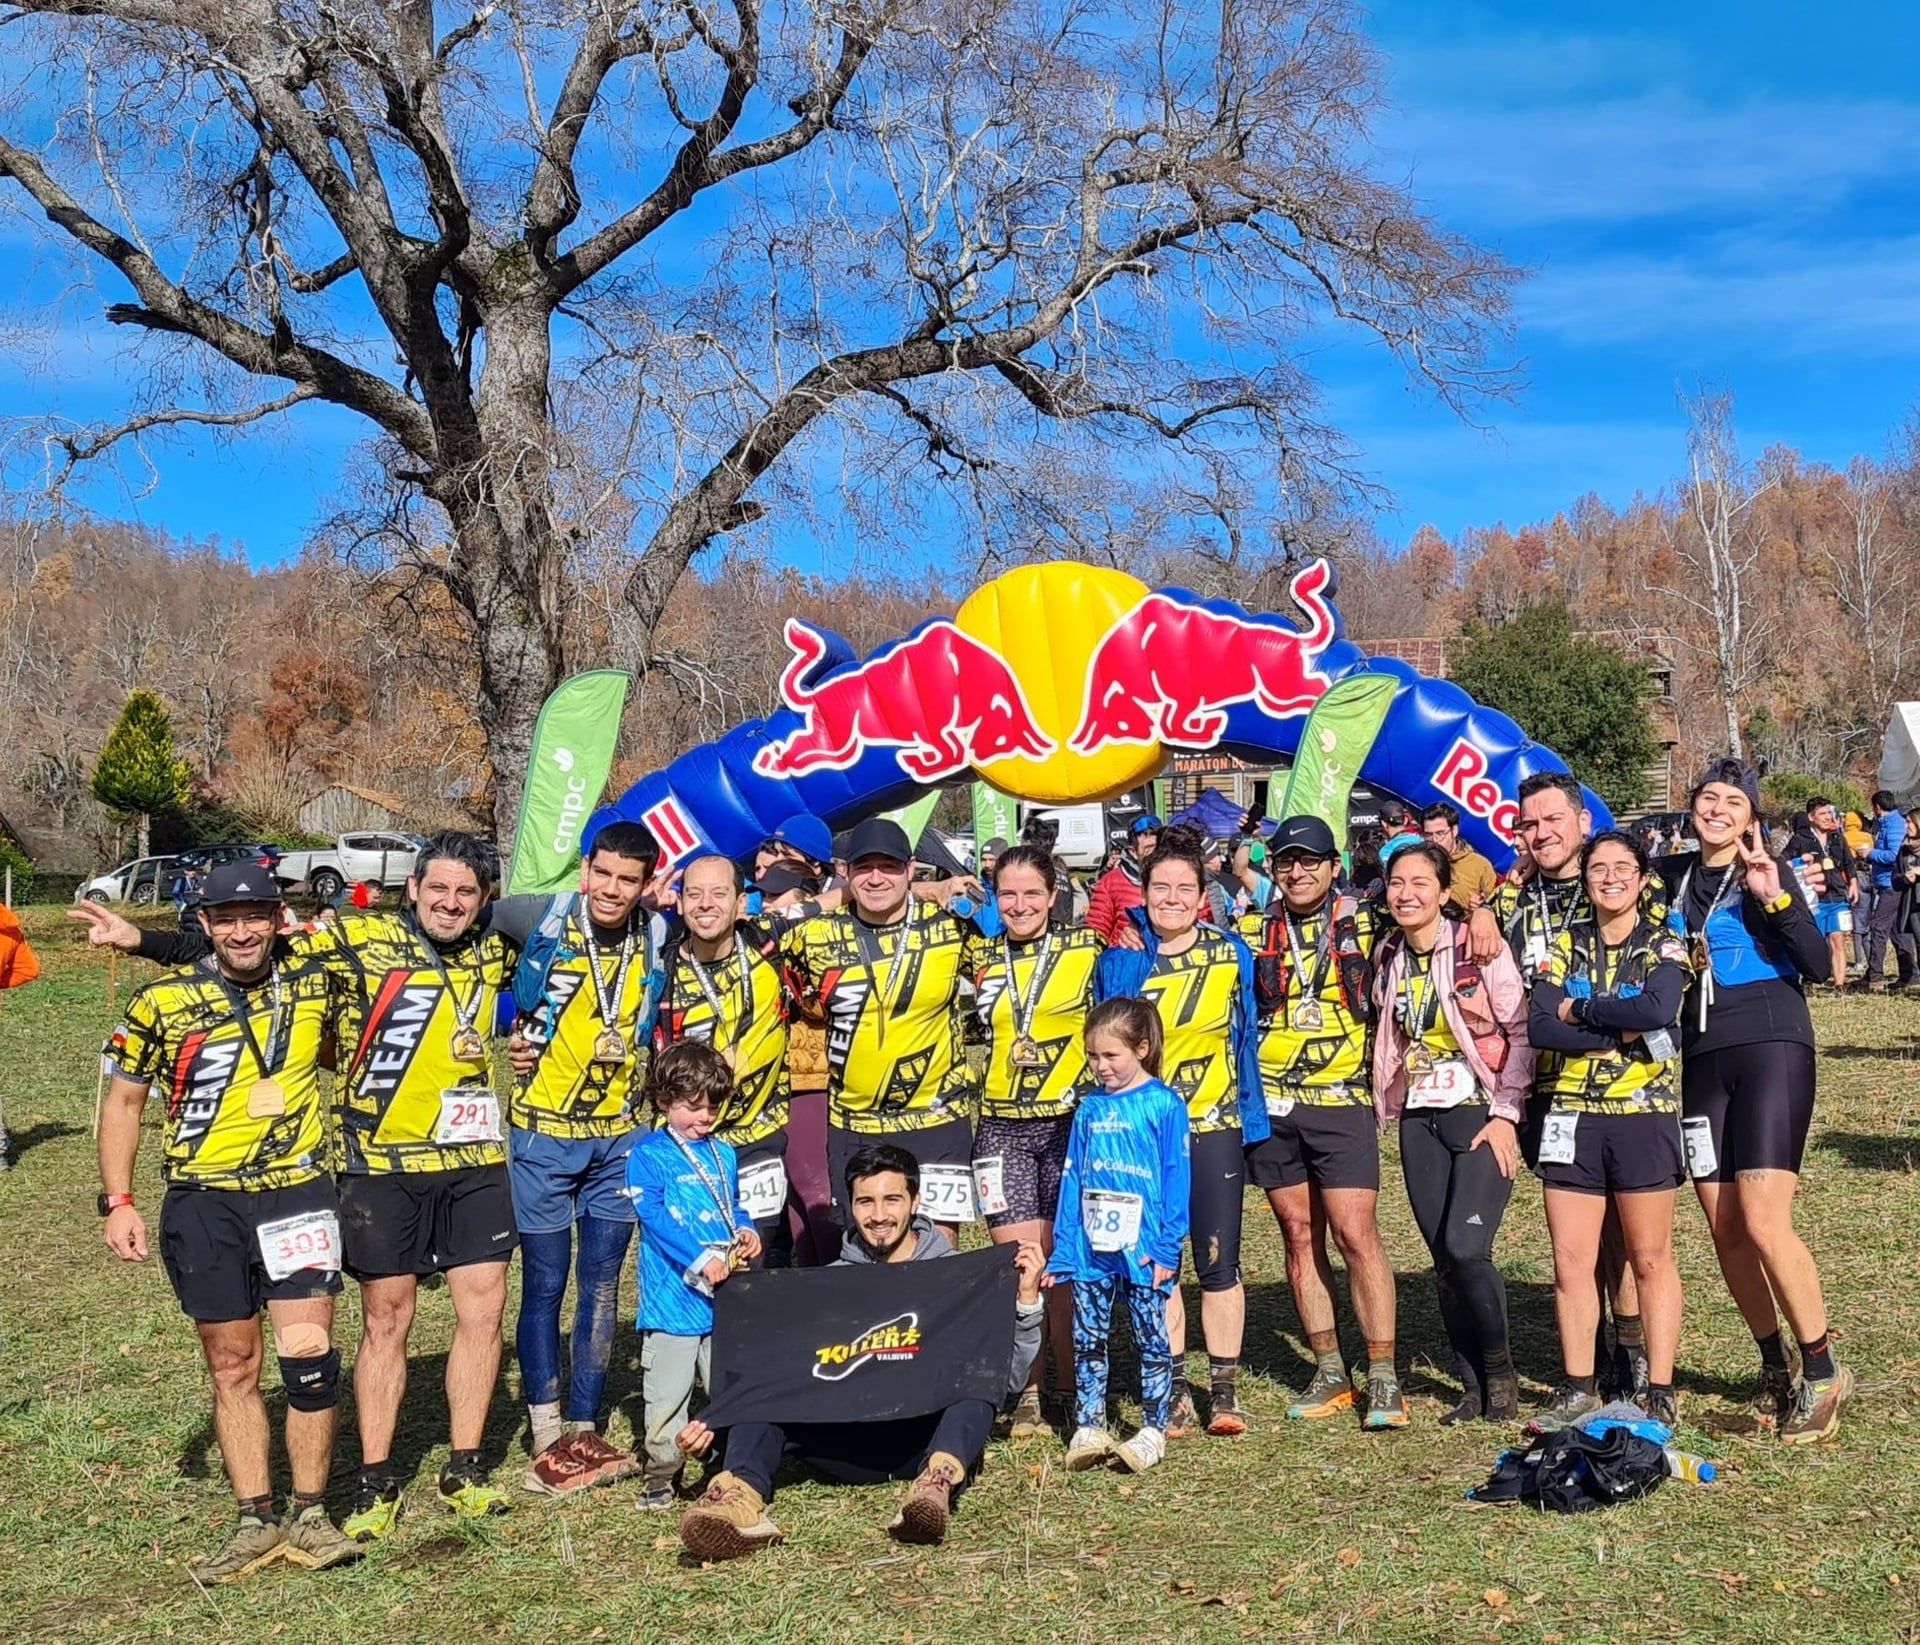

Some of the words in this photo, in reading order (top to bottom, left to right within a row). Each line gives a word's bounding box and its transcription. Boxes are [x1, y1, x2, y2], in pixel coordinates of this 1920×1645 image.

[1174, 757, 1228, 773] MARATON
[552, 775, 586, 854] cmpc
[1351, 814, 1379, 825] cmpc
[522, 974, 581, 1058] EAM
[828, 984, 869, 1064] TEAM
[358, 988, 438, 1096] TEAM
[174, 1041, 240, 1145] TEAM
[1104, 1159, 1152, 1179] Columbia
[925, 1182, 967, 1203] 575
[279, 1228, 331, 1260] 303
[876, 1353, 913, 1361] VALDIVIA
